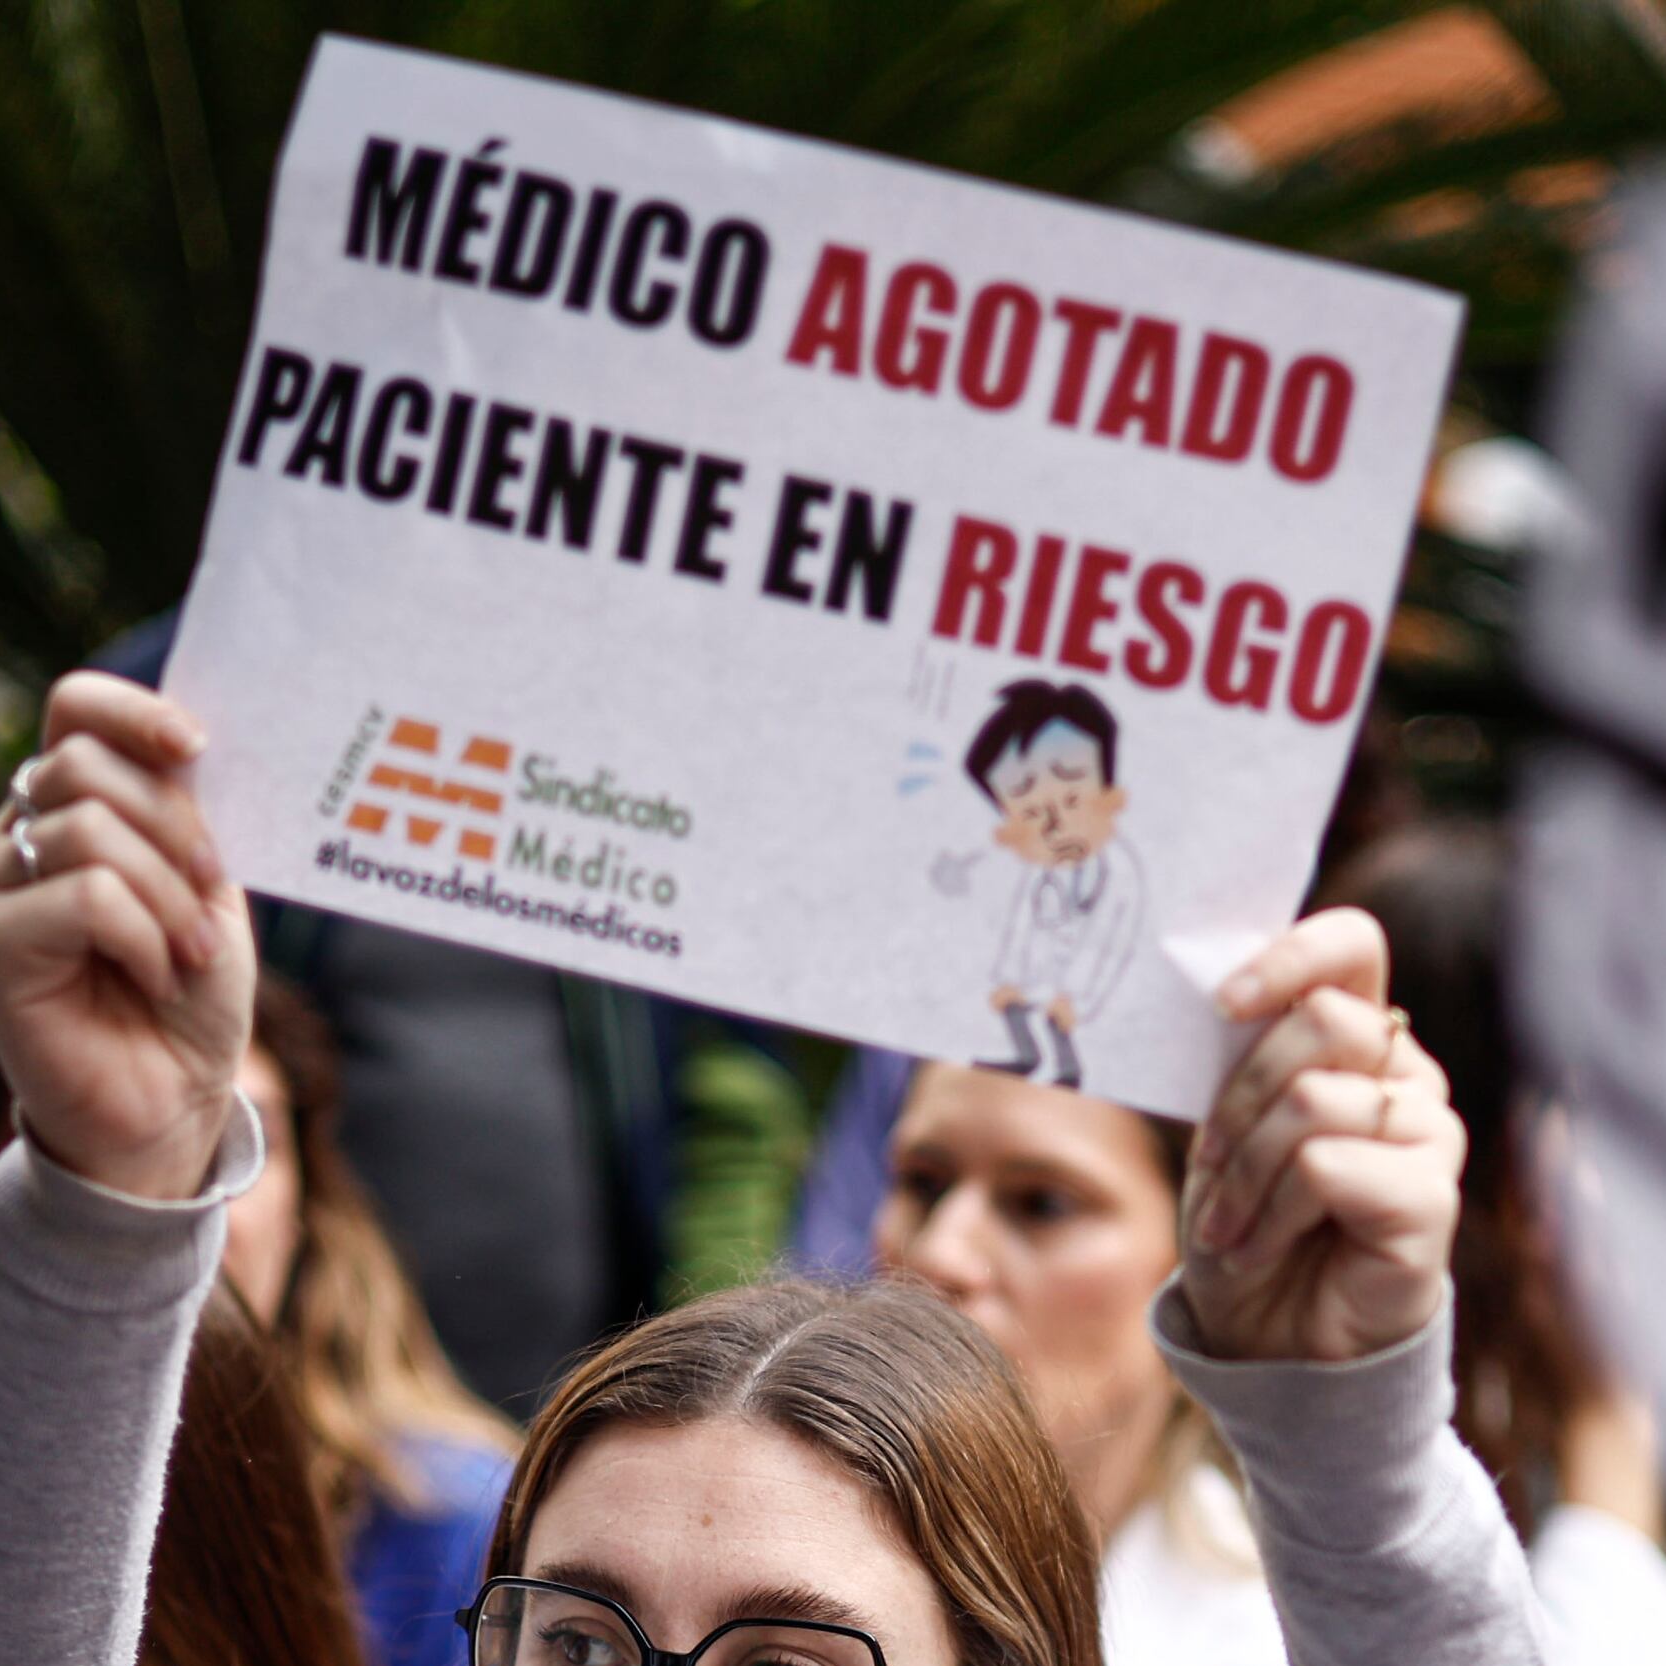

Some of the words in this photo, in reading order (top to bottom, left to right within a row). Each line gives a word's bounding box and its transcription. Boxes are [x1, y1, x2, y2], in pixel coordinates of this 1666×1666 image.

[343, 137, 771, 350] MÉDICO
[786, 243, 1354, 484] AGOTADO
[237, 346, 744, 583] PACIENTE
[761, 474, 914, 627] EN
[930, 514, 1374, 727] RIESGO
[516, 753, 692, 839] Sindicato
[315, 840, 682, 957] #lavozdelosmédicos
[507, 827, 677, 907] Médico
